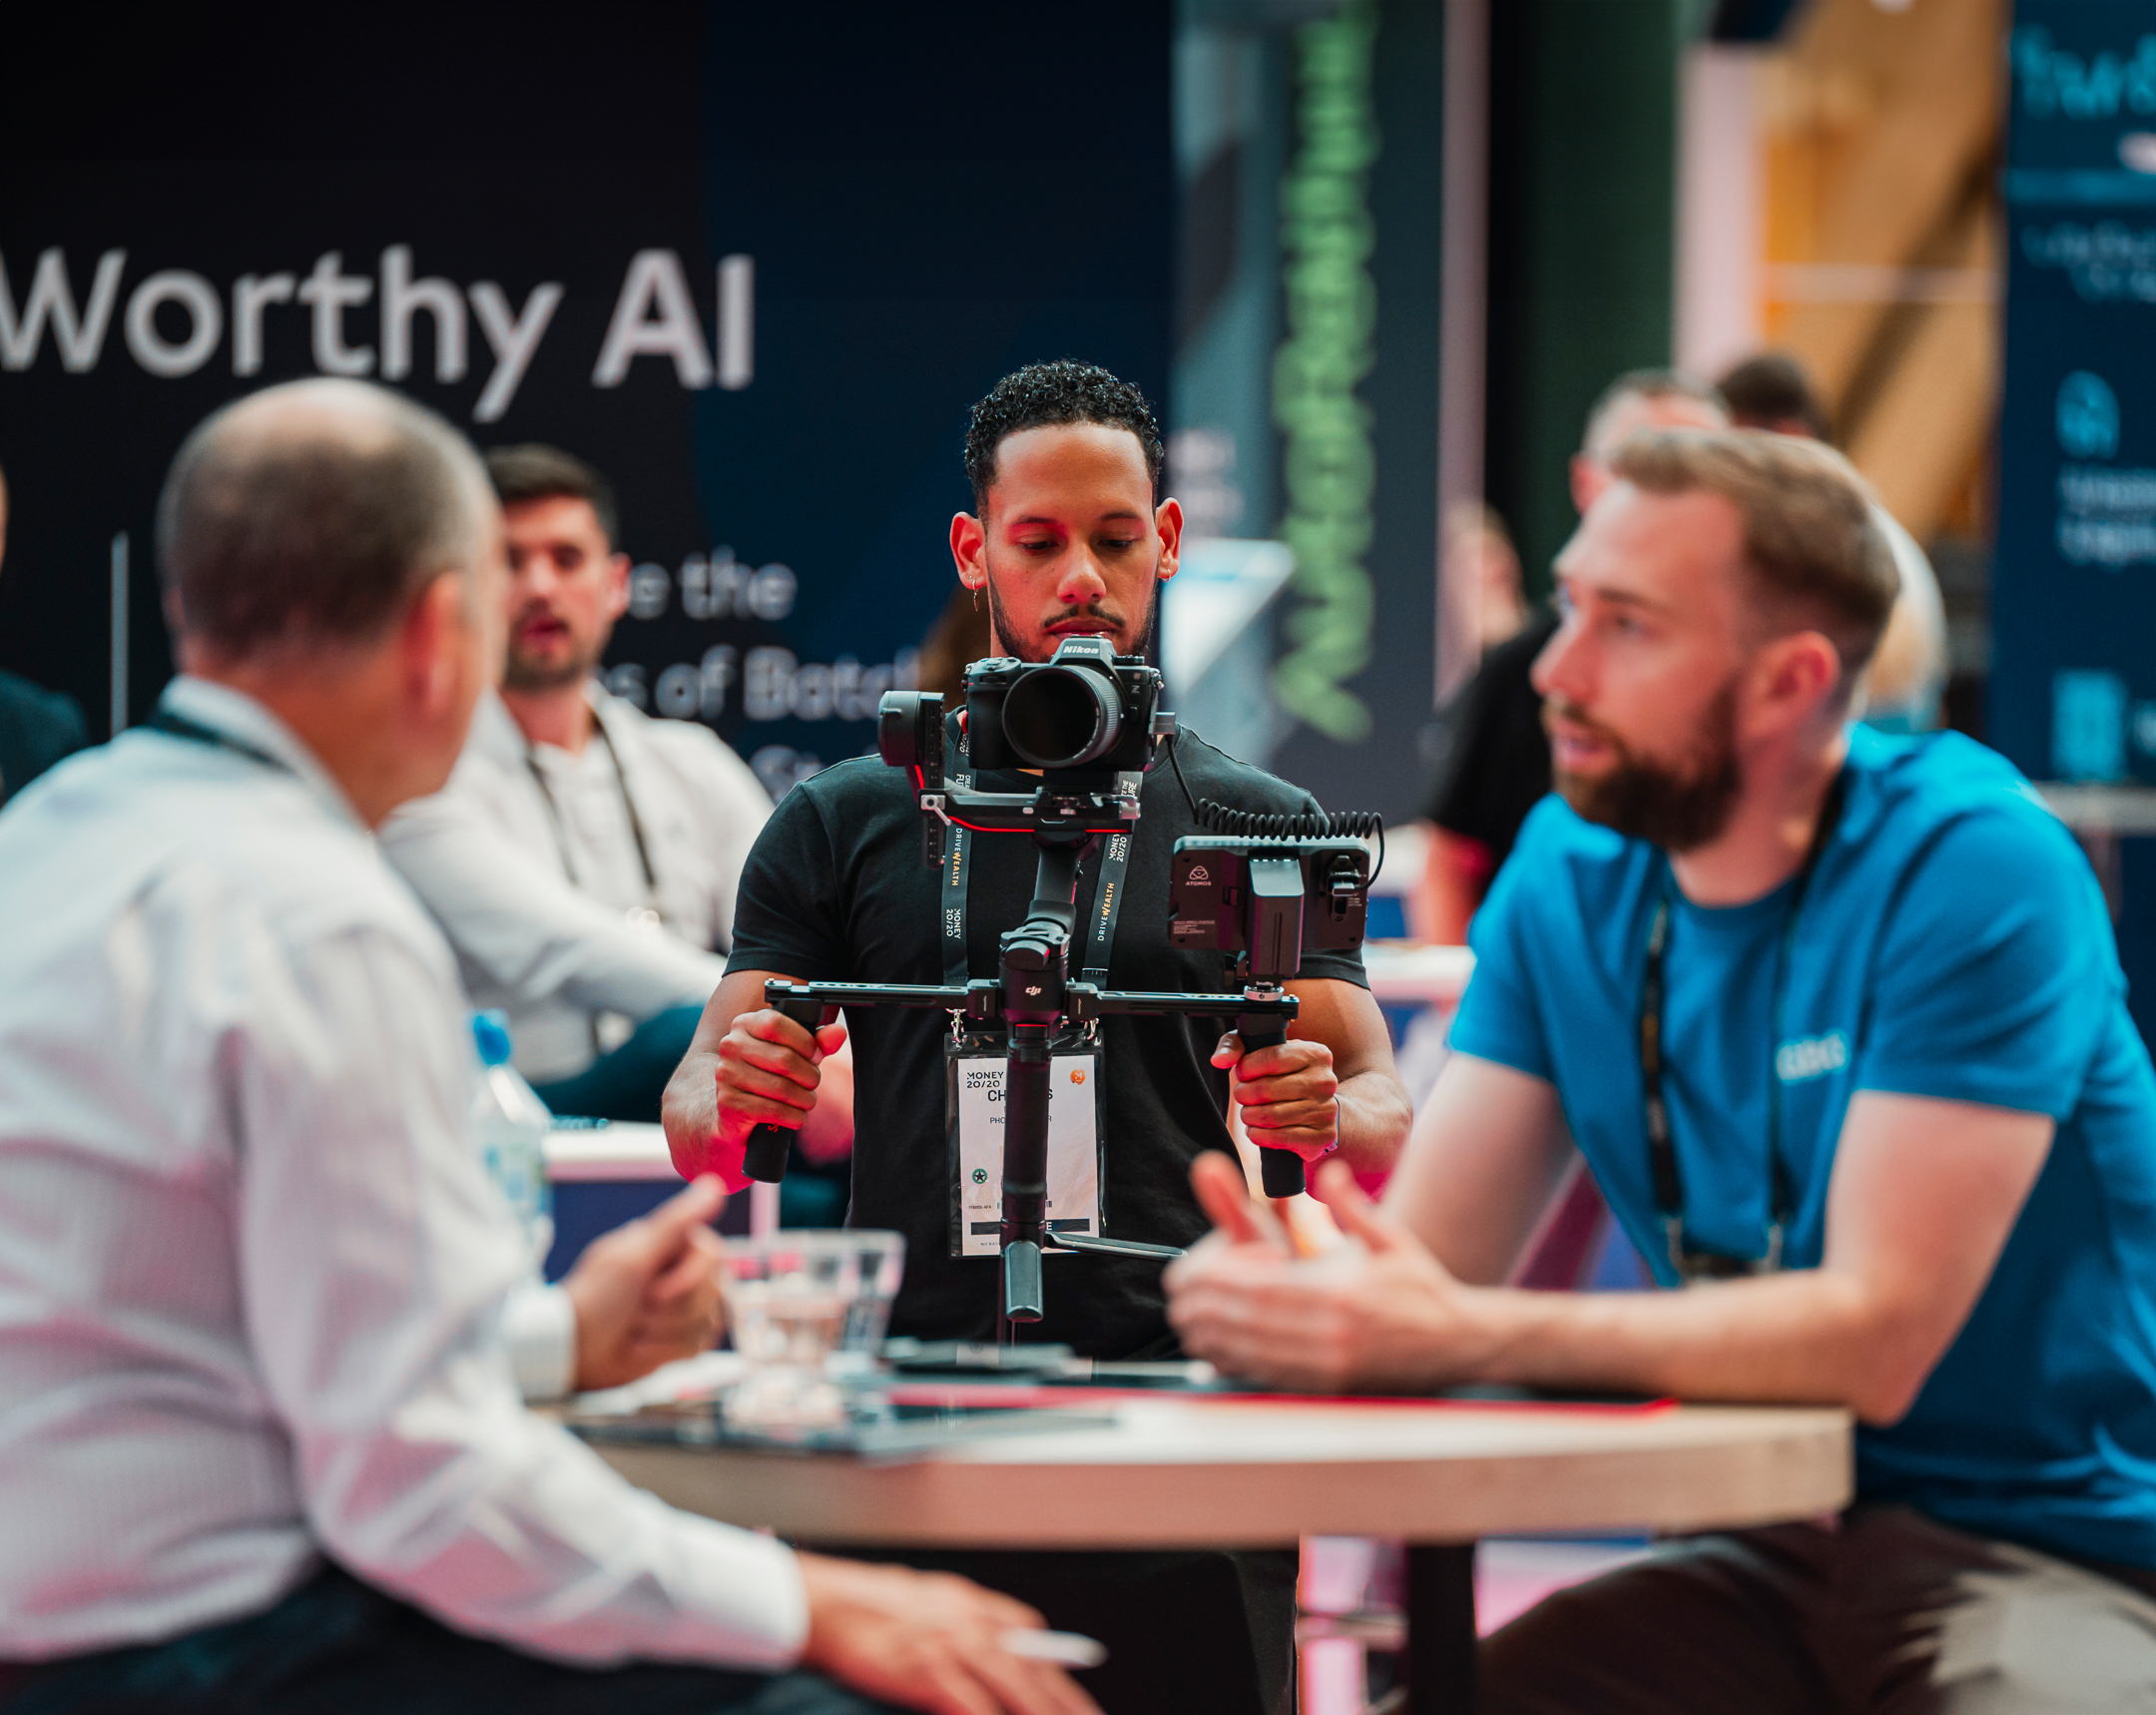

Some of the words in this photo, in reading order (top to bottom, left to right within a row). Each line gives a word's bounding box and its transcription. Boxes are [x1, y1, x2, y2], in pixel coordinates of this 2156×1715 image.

[0, 245, 565, 422] Worthy
[592, 249, 756, 389] AI
[1063, 645, 1099, 655] Nikon
[1131, 685, 1140, 694] Z
[951, 828, 963, 886] DRIVEWEALTH
[1116, 837, 1127, 861] 20/20
[1097, 882, 1115, 941] DRIVEWEALTH
[966, 1071, 1004, 1080] MONEY
[966, 1080, 1000, 1089] 20/20
